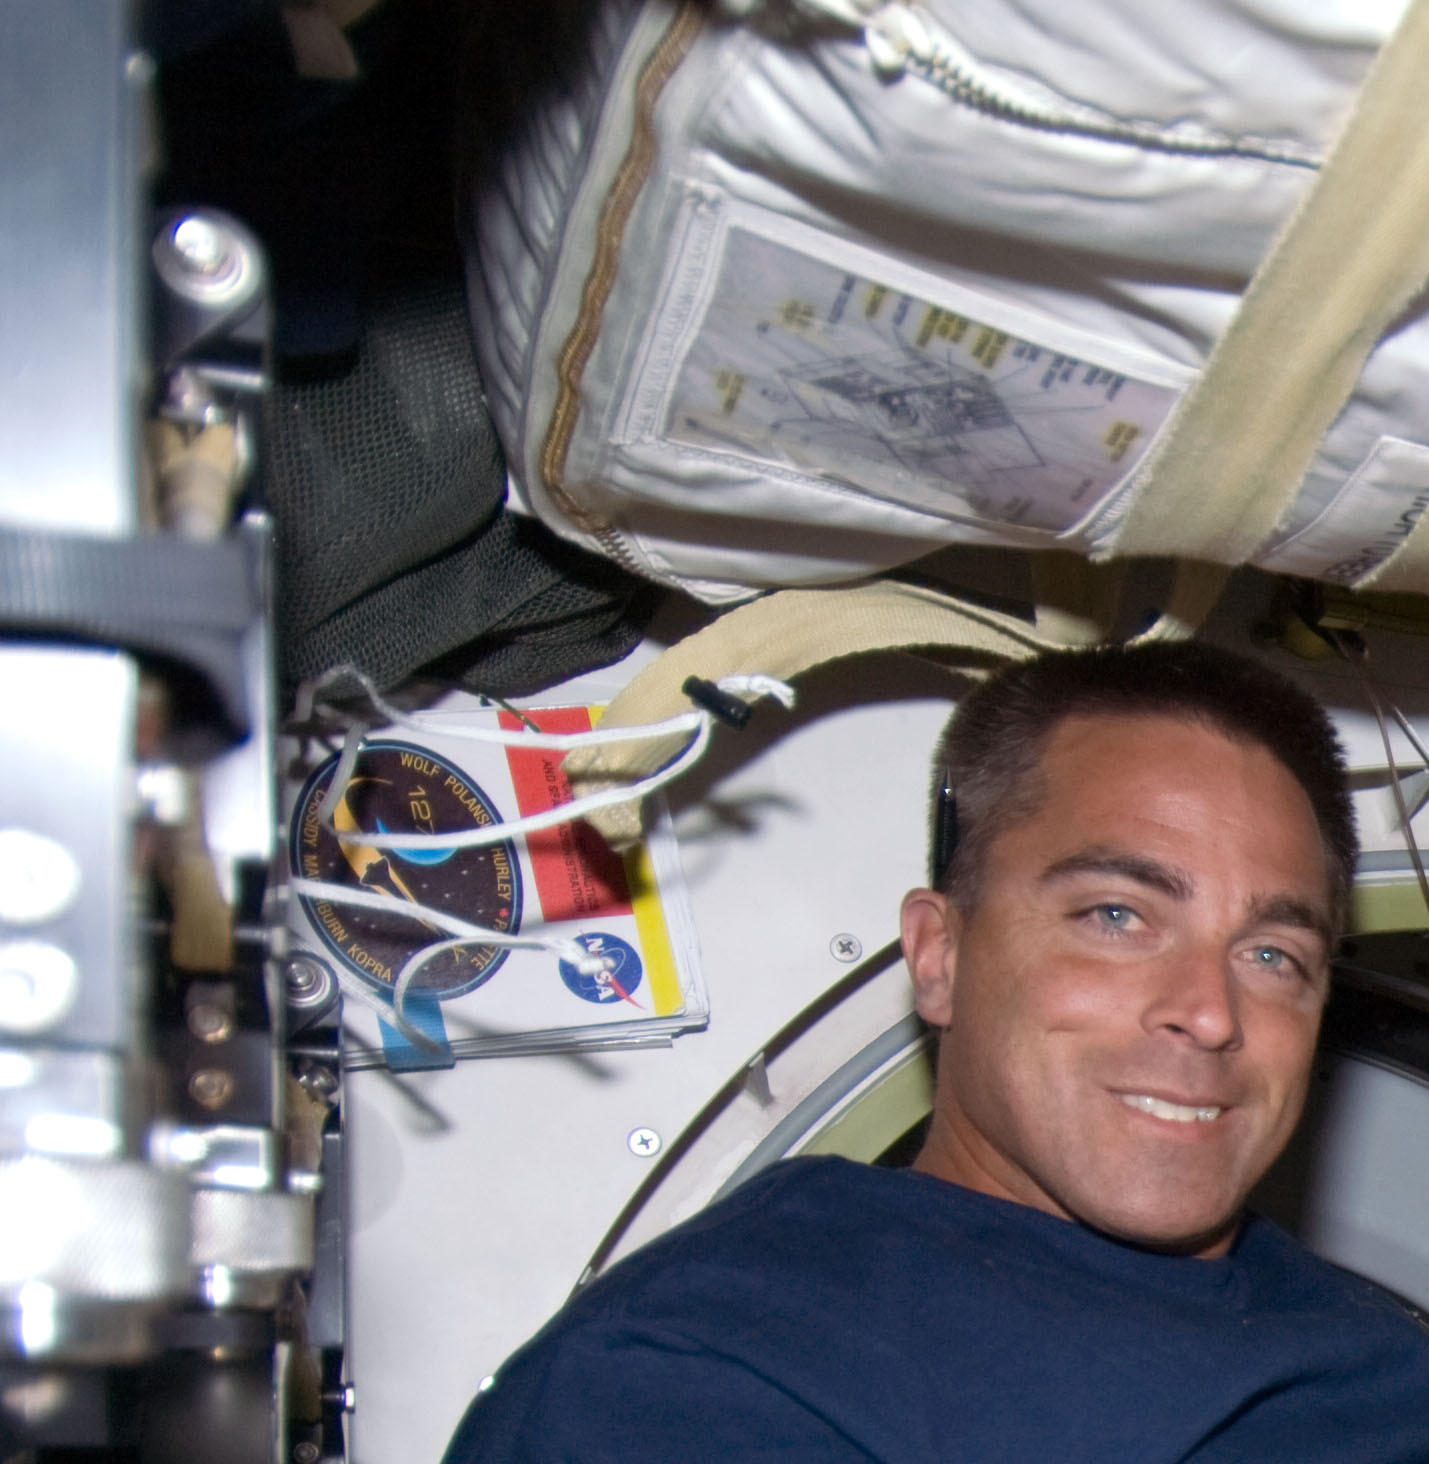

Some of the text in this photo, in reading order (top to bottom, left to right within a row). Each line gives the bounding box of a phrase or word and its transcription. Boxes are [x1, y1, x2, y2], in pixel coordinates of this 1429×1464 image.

[401, 752, 511, 901] WOLF POLANS HURLEY
[347, 944, 392, 982] KOPRA
[586, 937, 615, 1001] NSA
